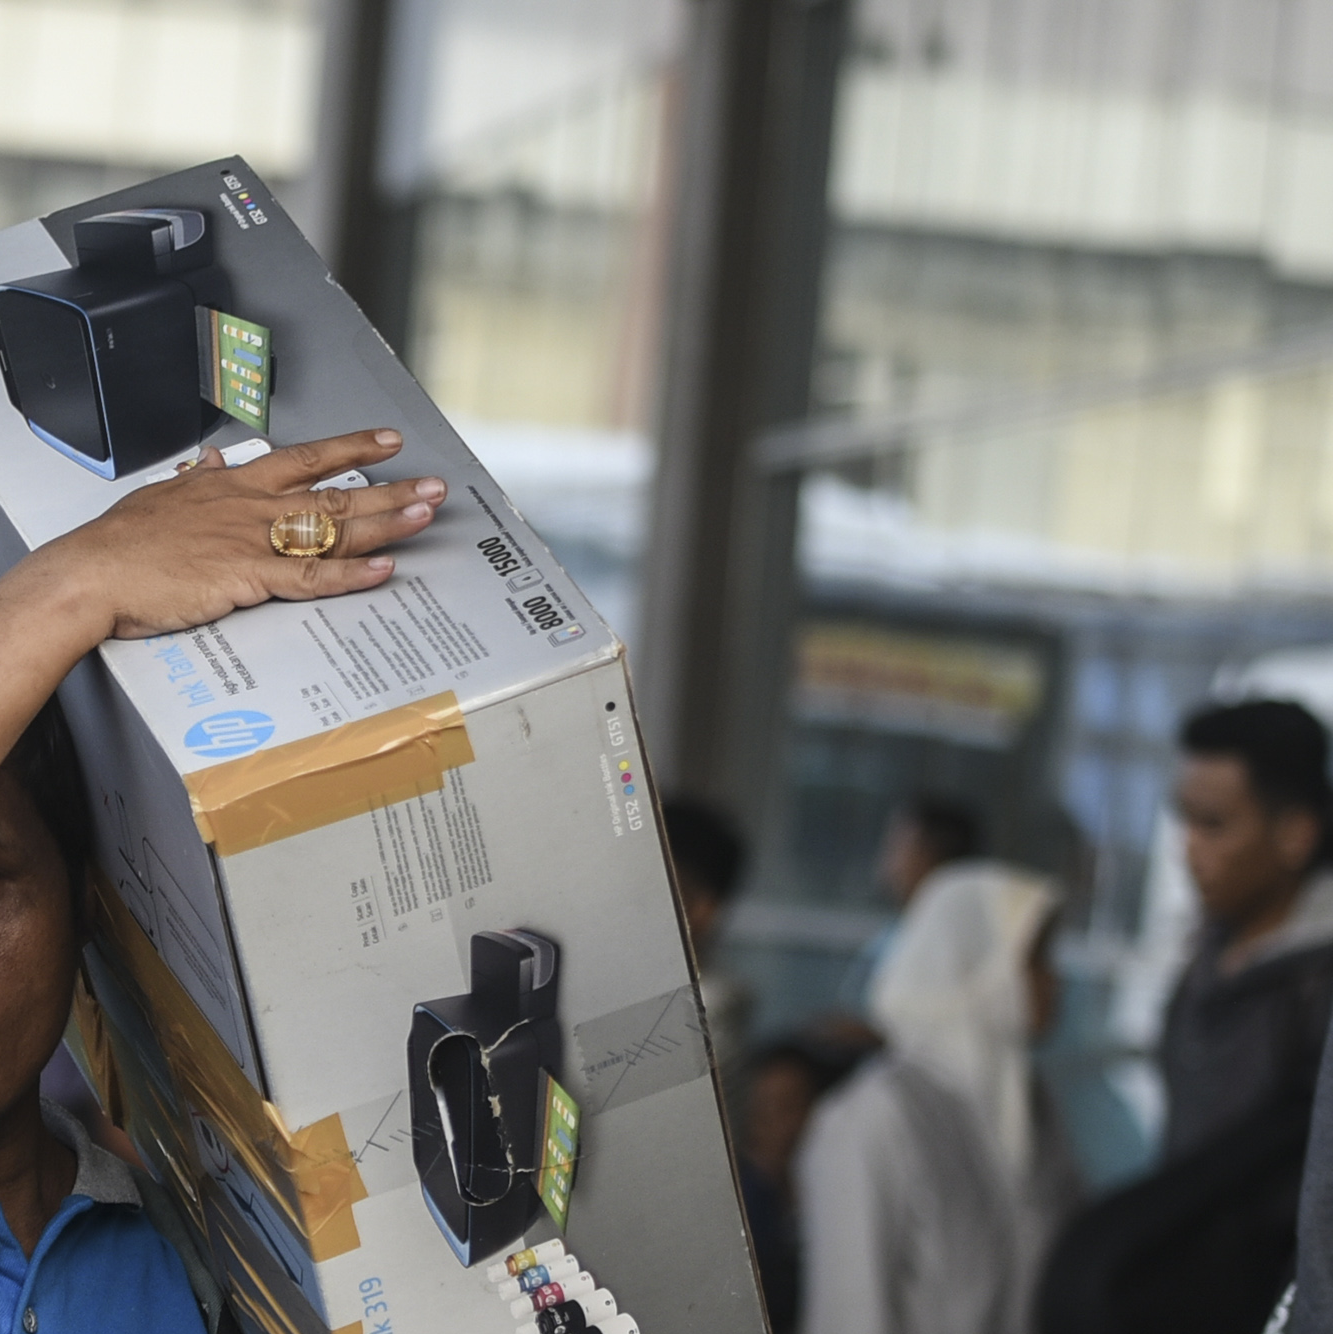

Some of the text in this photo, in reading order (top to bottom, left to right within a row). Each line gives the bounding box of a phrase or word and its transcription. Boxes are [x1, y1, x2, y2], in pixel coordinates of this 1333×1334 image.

[477, 537, 563, 630] 8000 15000
[155, 644, 196, 683] Tank
[214, 634, 233, 654] volume
[192, 633, 237, 695] High-volume printing.
[229, 656, 256, 689] Pencetakan
[178, 680, 215, 708] Ink
[607, 717, 642, 830] GT52 GT51
[600, 754, 622, 836] HP Original Ink Bottles
[356, 906, 364, 921] Scan
[365, 902, 373, 917] Scan
[359, 1276, 388, 1318] 319
